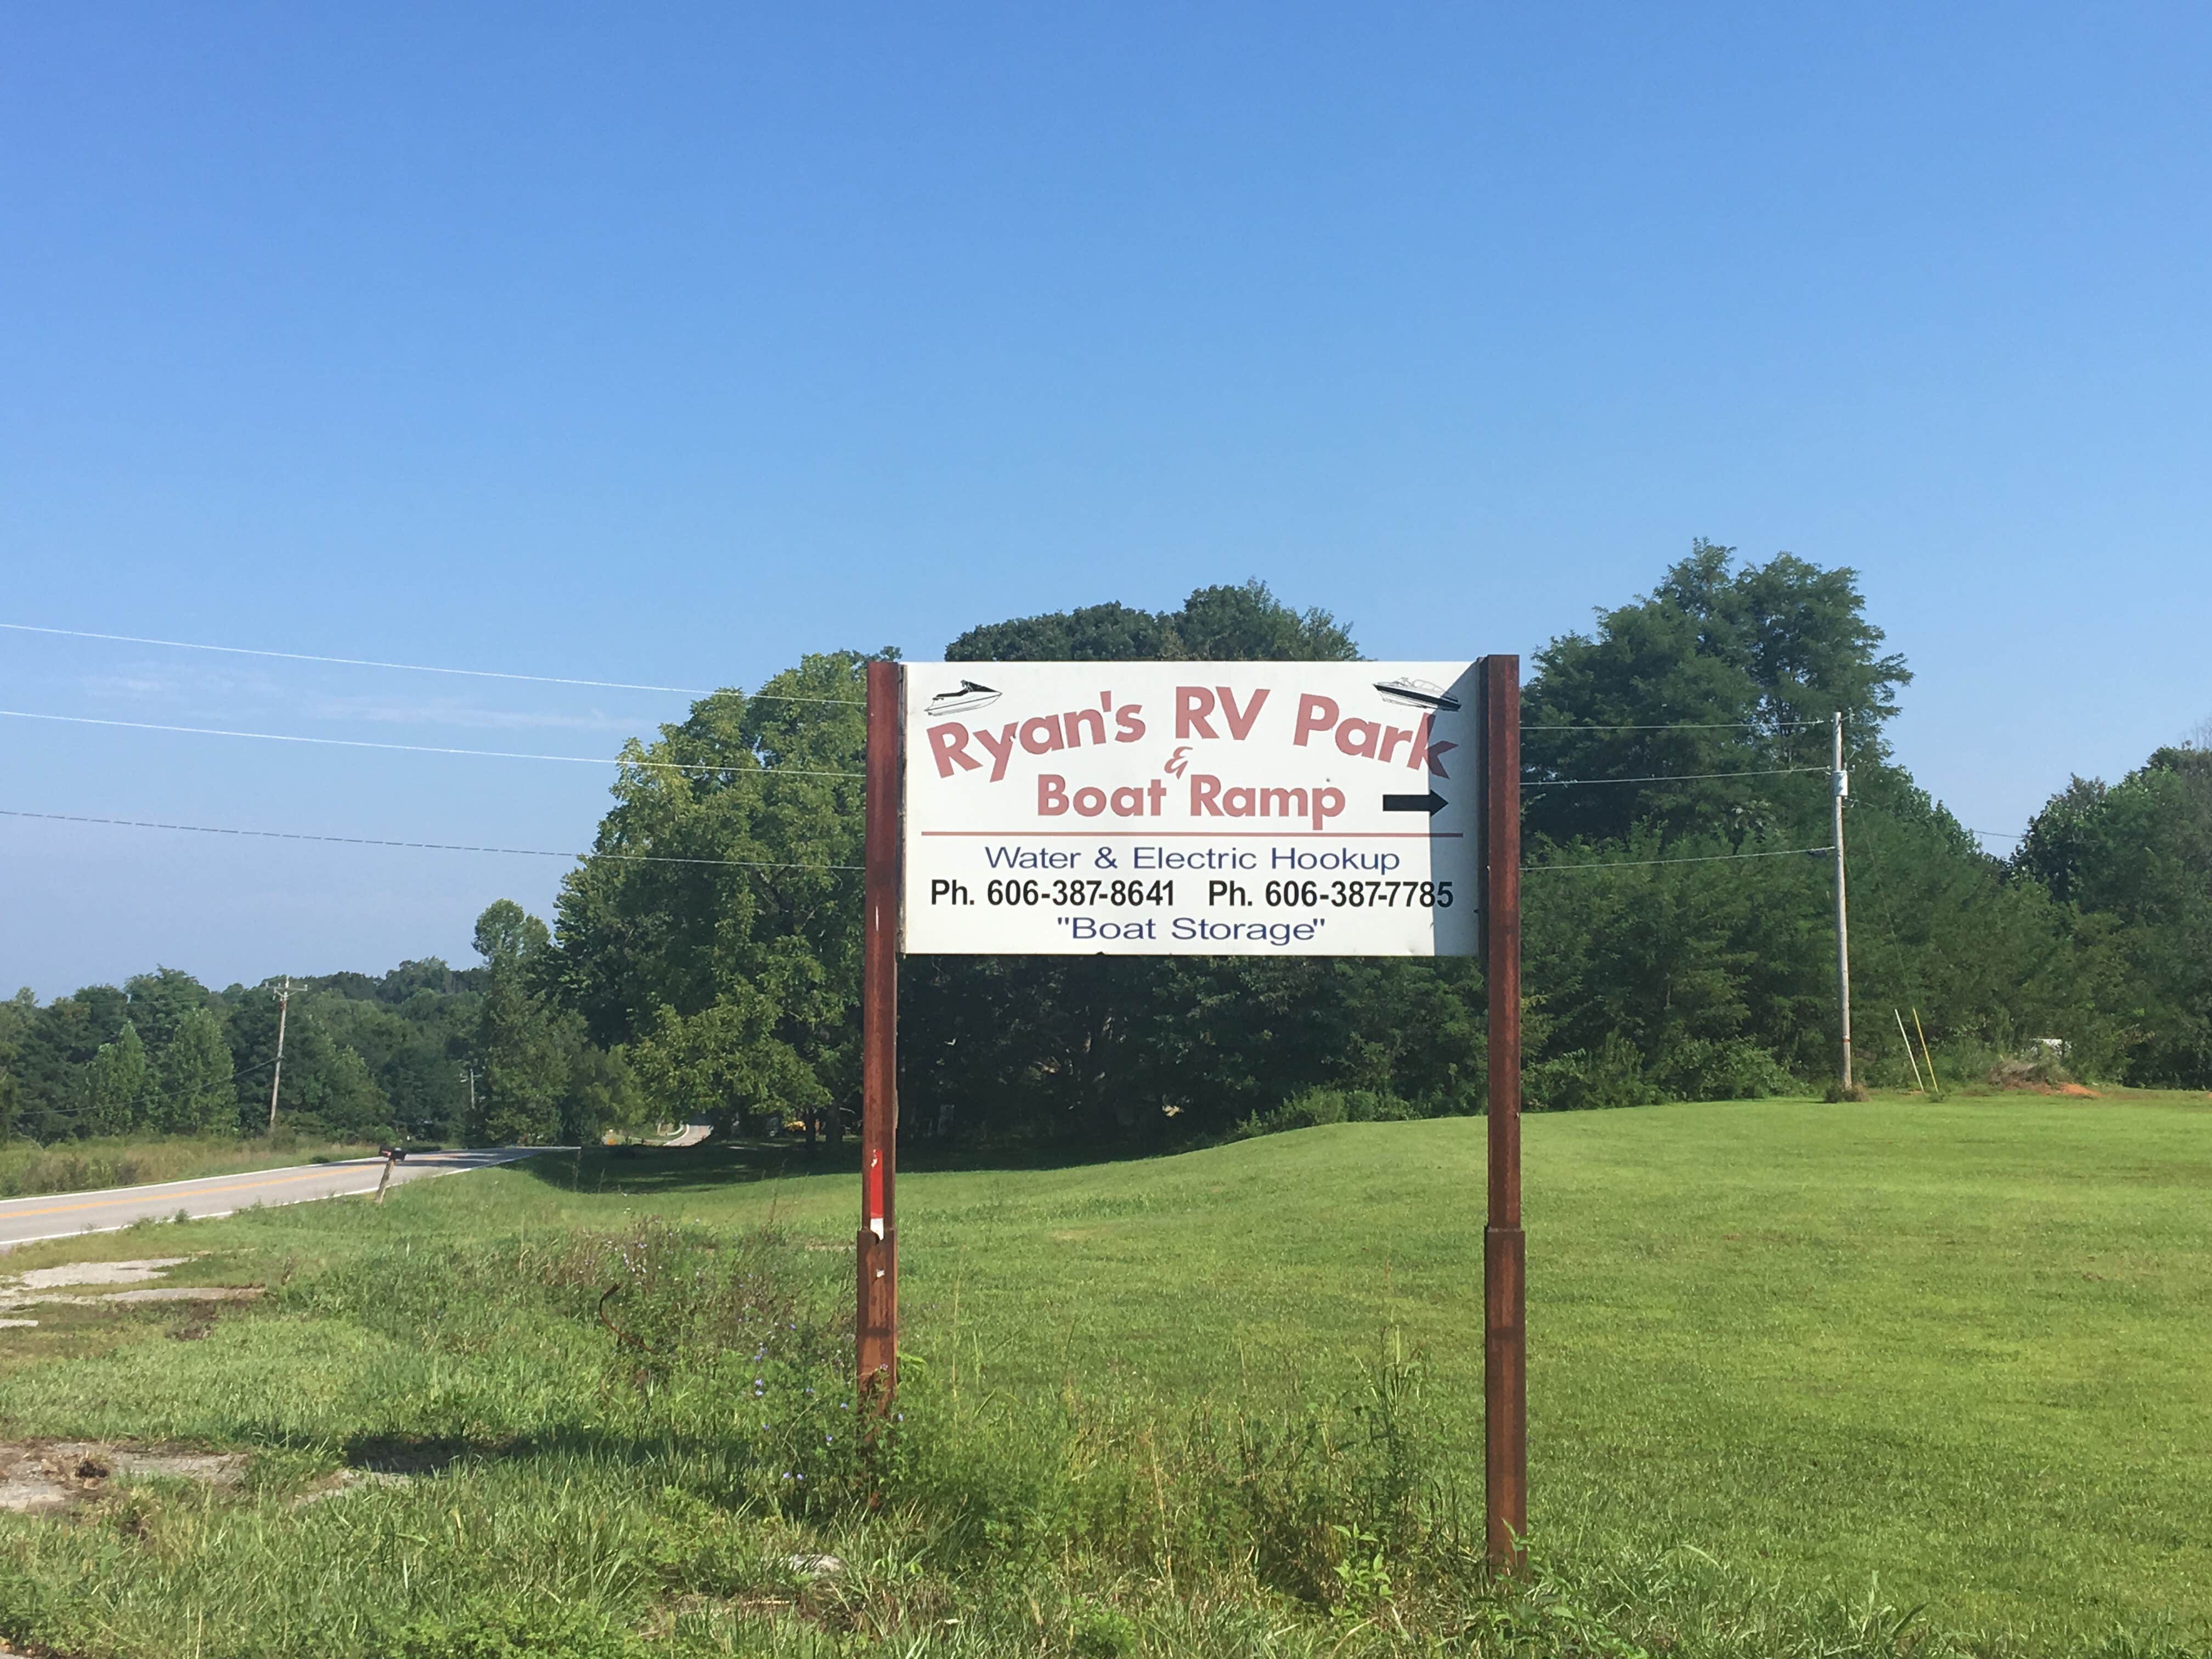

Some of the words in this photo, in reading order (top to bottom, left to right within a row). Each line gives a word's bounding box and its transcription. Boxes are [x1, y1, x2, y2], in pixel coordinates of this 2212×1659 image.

[926, 691, 1146, 783] Ryan's
[1176, 686, 1270, 740] RV
[1293, 693, 1458, 779] Park
[1164, 746, 1194, 780] &
[1037, 774, 1166, 816] Boat
[1190, 775, 1345, 831] Ramp
[985, 847, 1082, 869] Water
[1094, 847, 1118, 869] &
[1133, 847, 1257, 870] Electric
[1272, 848, 1400, 875] Hookup
[932, 879, 975, 906] Ph.
[987, 879, 1173, 907] 606-387-8641
[1209, 880, 1253, 907] Ph.
[1266, 879, 1454, 908] 606-387-7785
[1058, 917, 1156, 940] "Boat
[1172, 917, 1325, 946] Storage"
